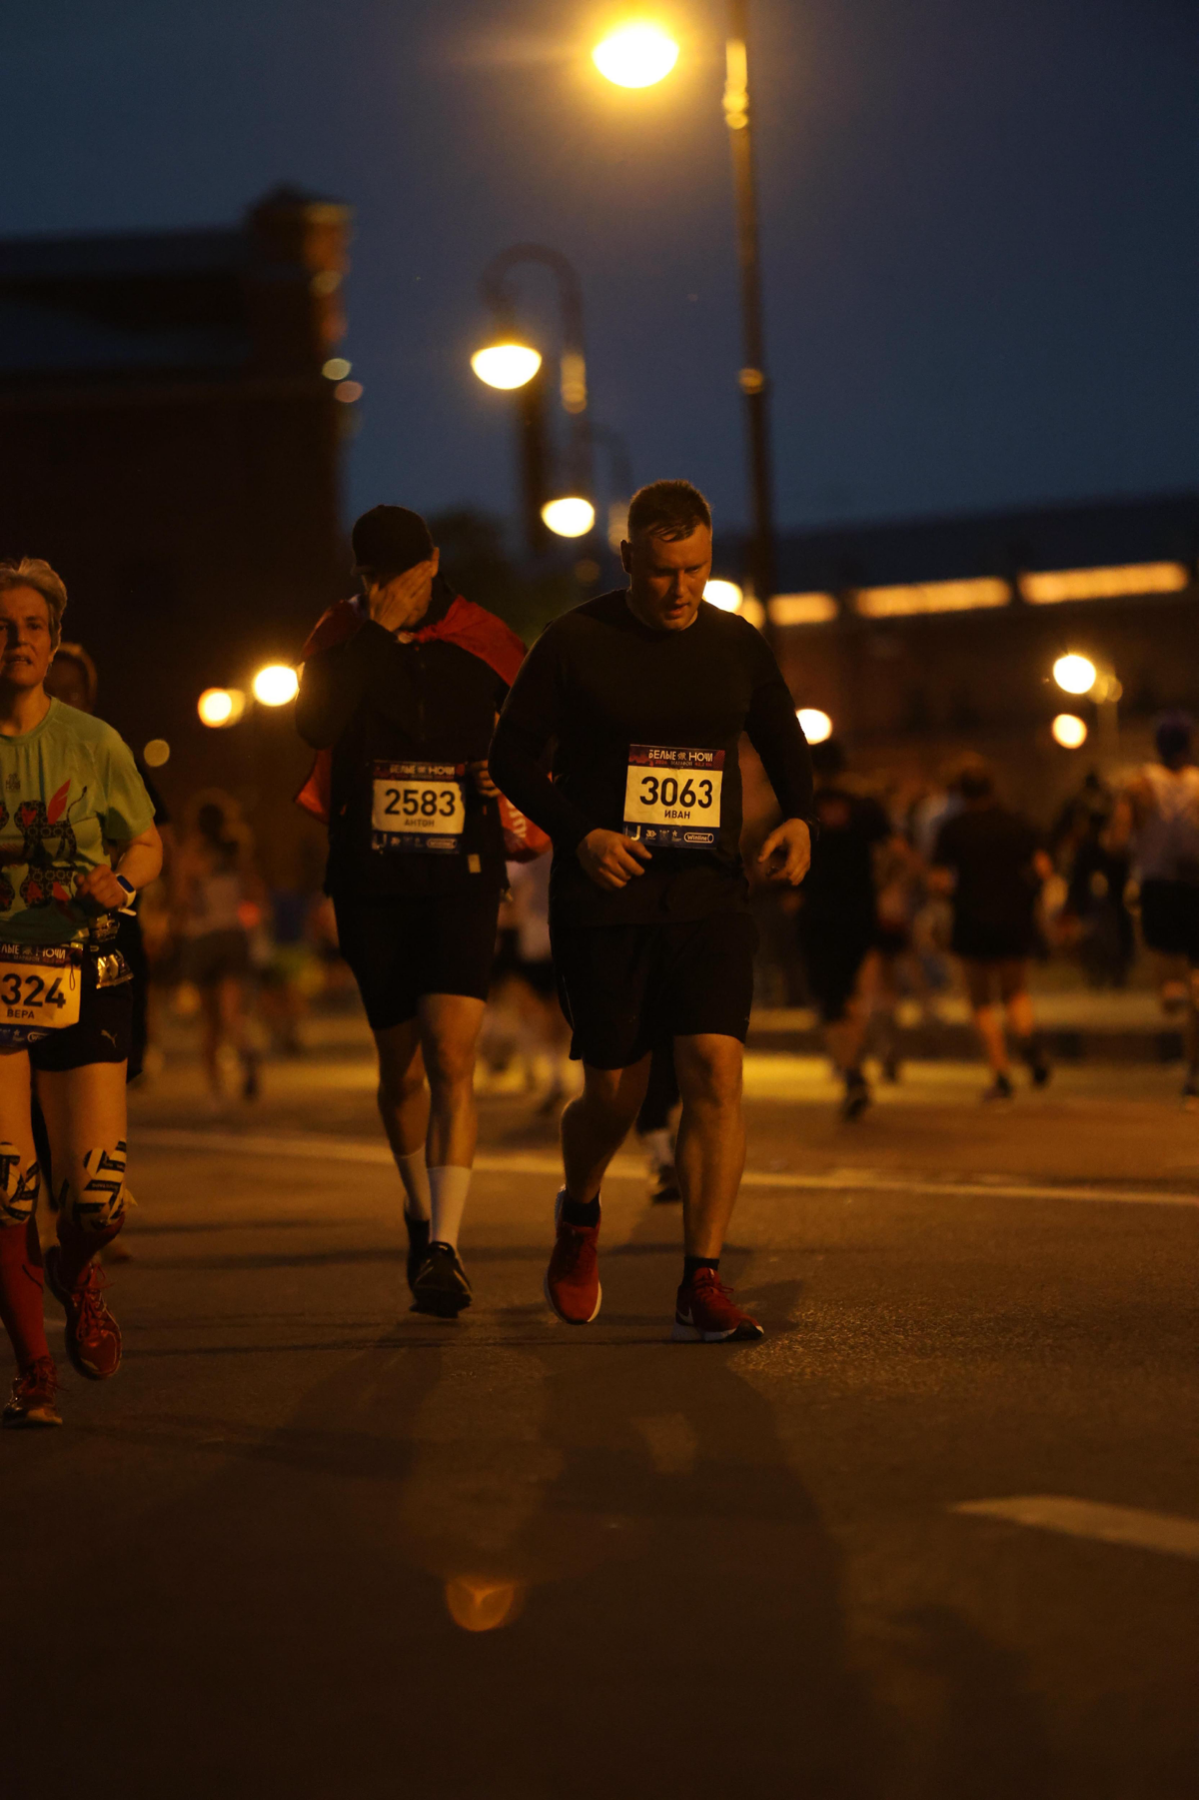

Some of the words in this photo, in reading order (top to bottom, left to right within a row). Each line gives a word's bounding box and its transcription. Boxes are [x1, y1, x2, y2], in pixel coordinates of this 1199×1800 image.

[689, 751, 714, 762] НОЧИ
[640, 776, 712, 809] 3063
[385, 790, 455, 816] 2583
[664, 809, 691, 820] ИВАН
[404, 818, 434, 828] АНТОН
[0, 973, 66, 1009] 324
[6, 1009, 35, 1019] ВЕРА
